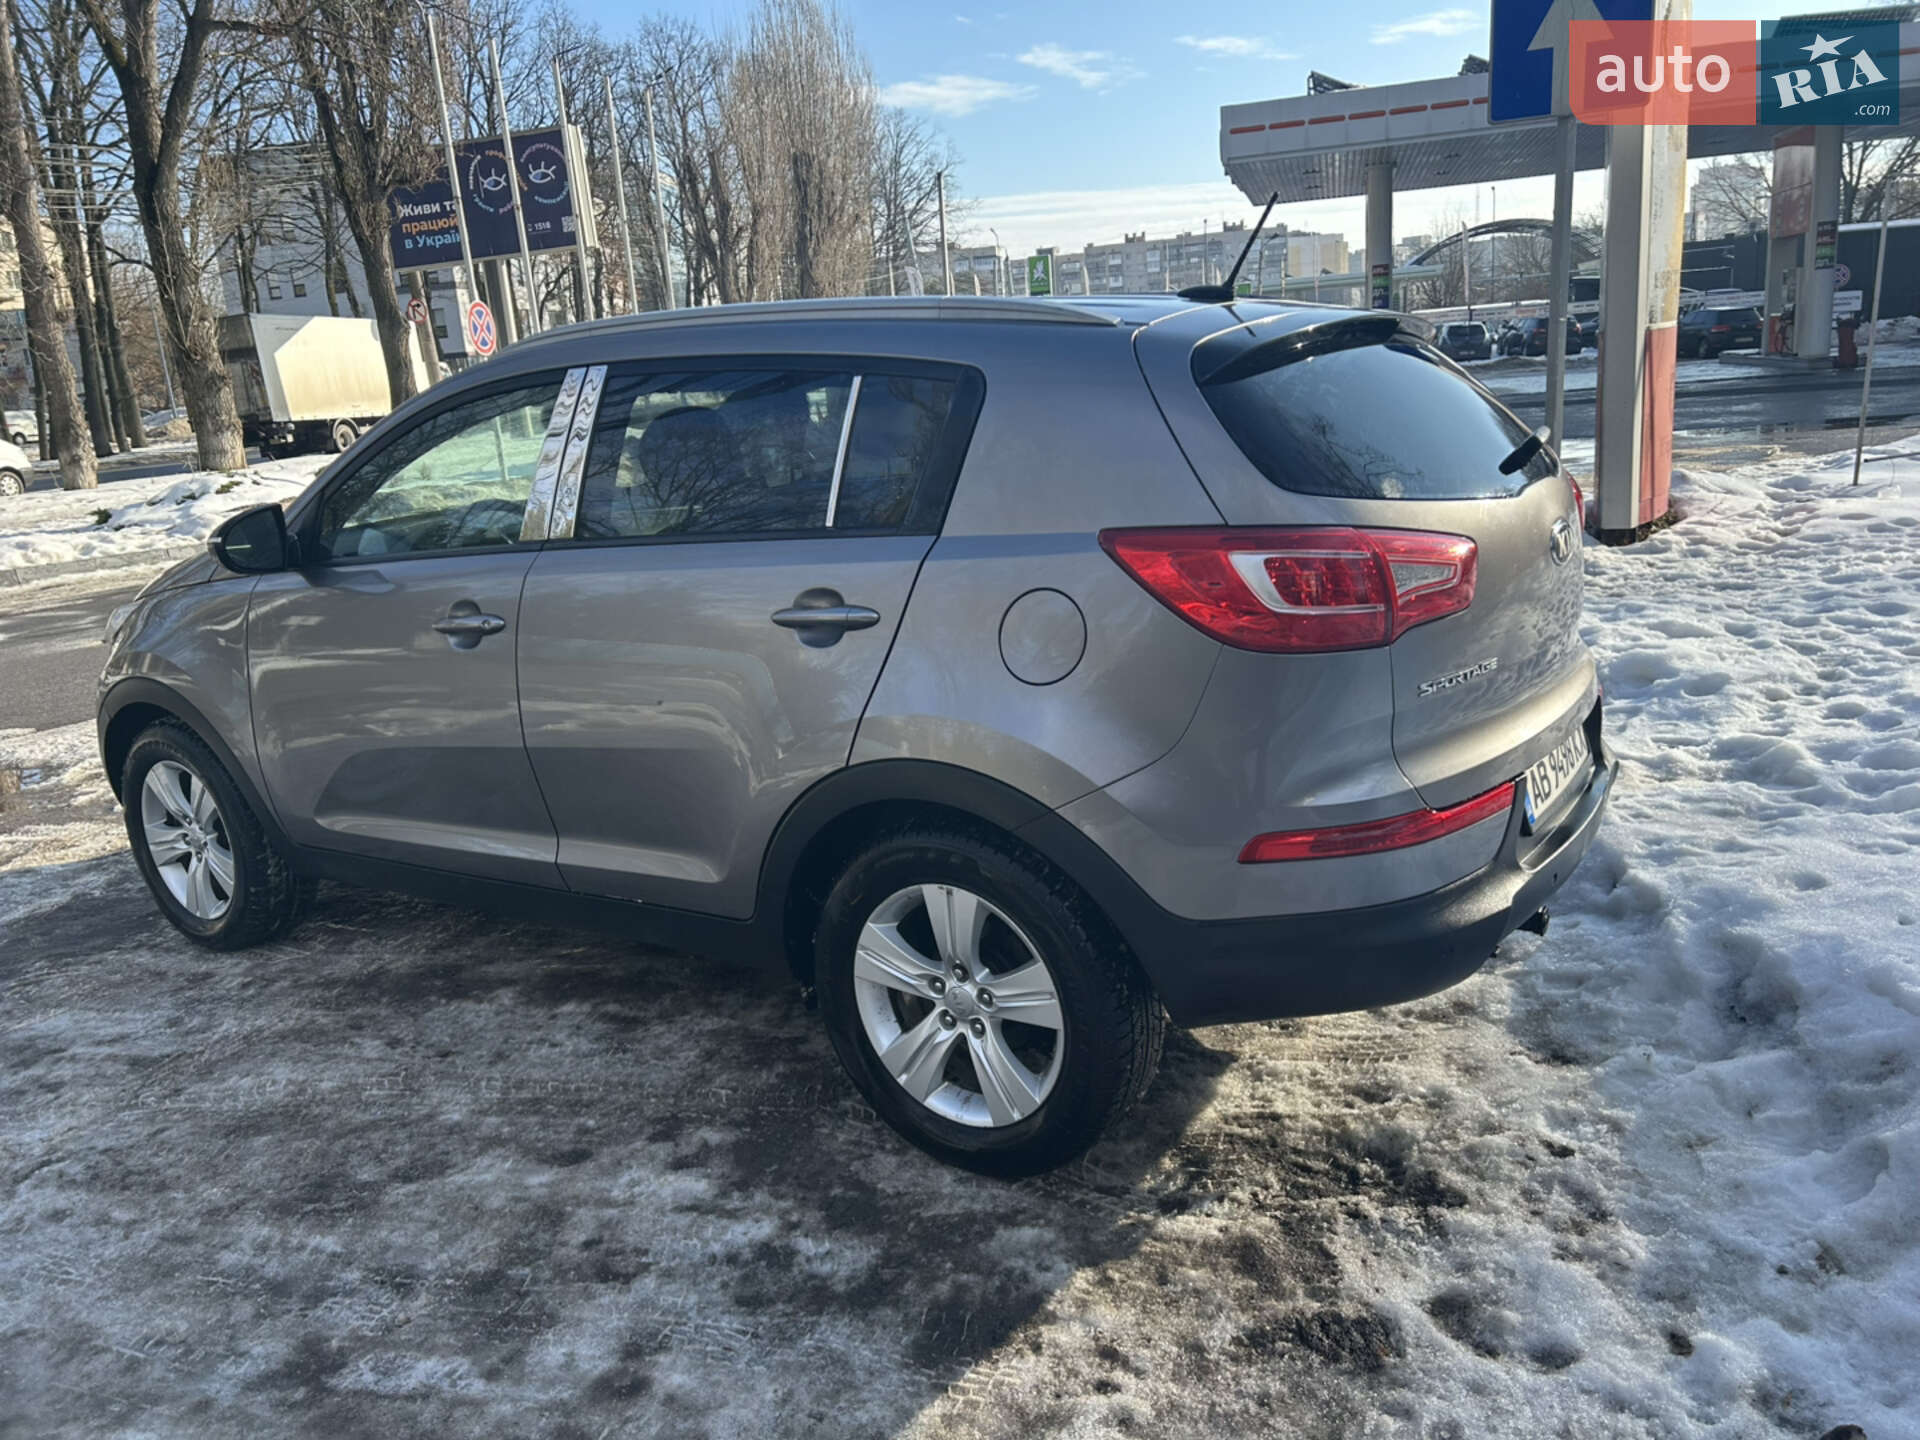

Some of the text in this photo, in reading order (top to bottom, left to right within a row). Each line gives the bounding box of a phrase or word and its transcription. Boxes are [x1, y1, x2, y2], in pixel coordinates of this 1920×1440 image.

[399, 202, 441, 217] Живи
[402, 214, 460, 235] працюй
[404, 238, 414, 249] в
[1418, 657, 1498, 697] SPORTAGE
